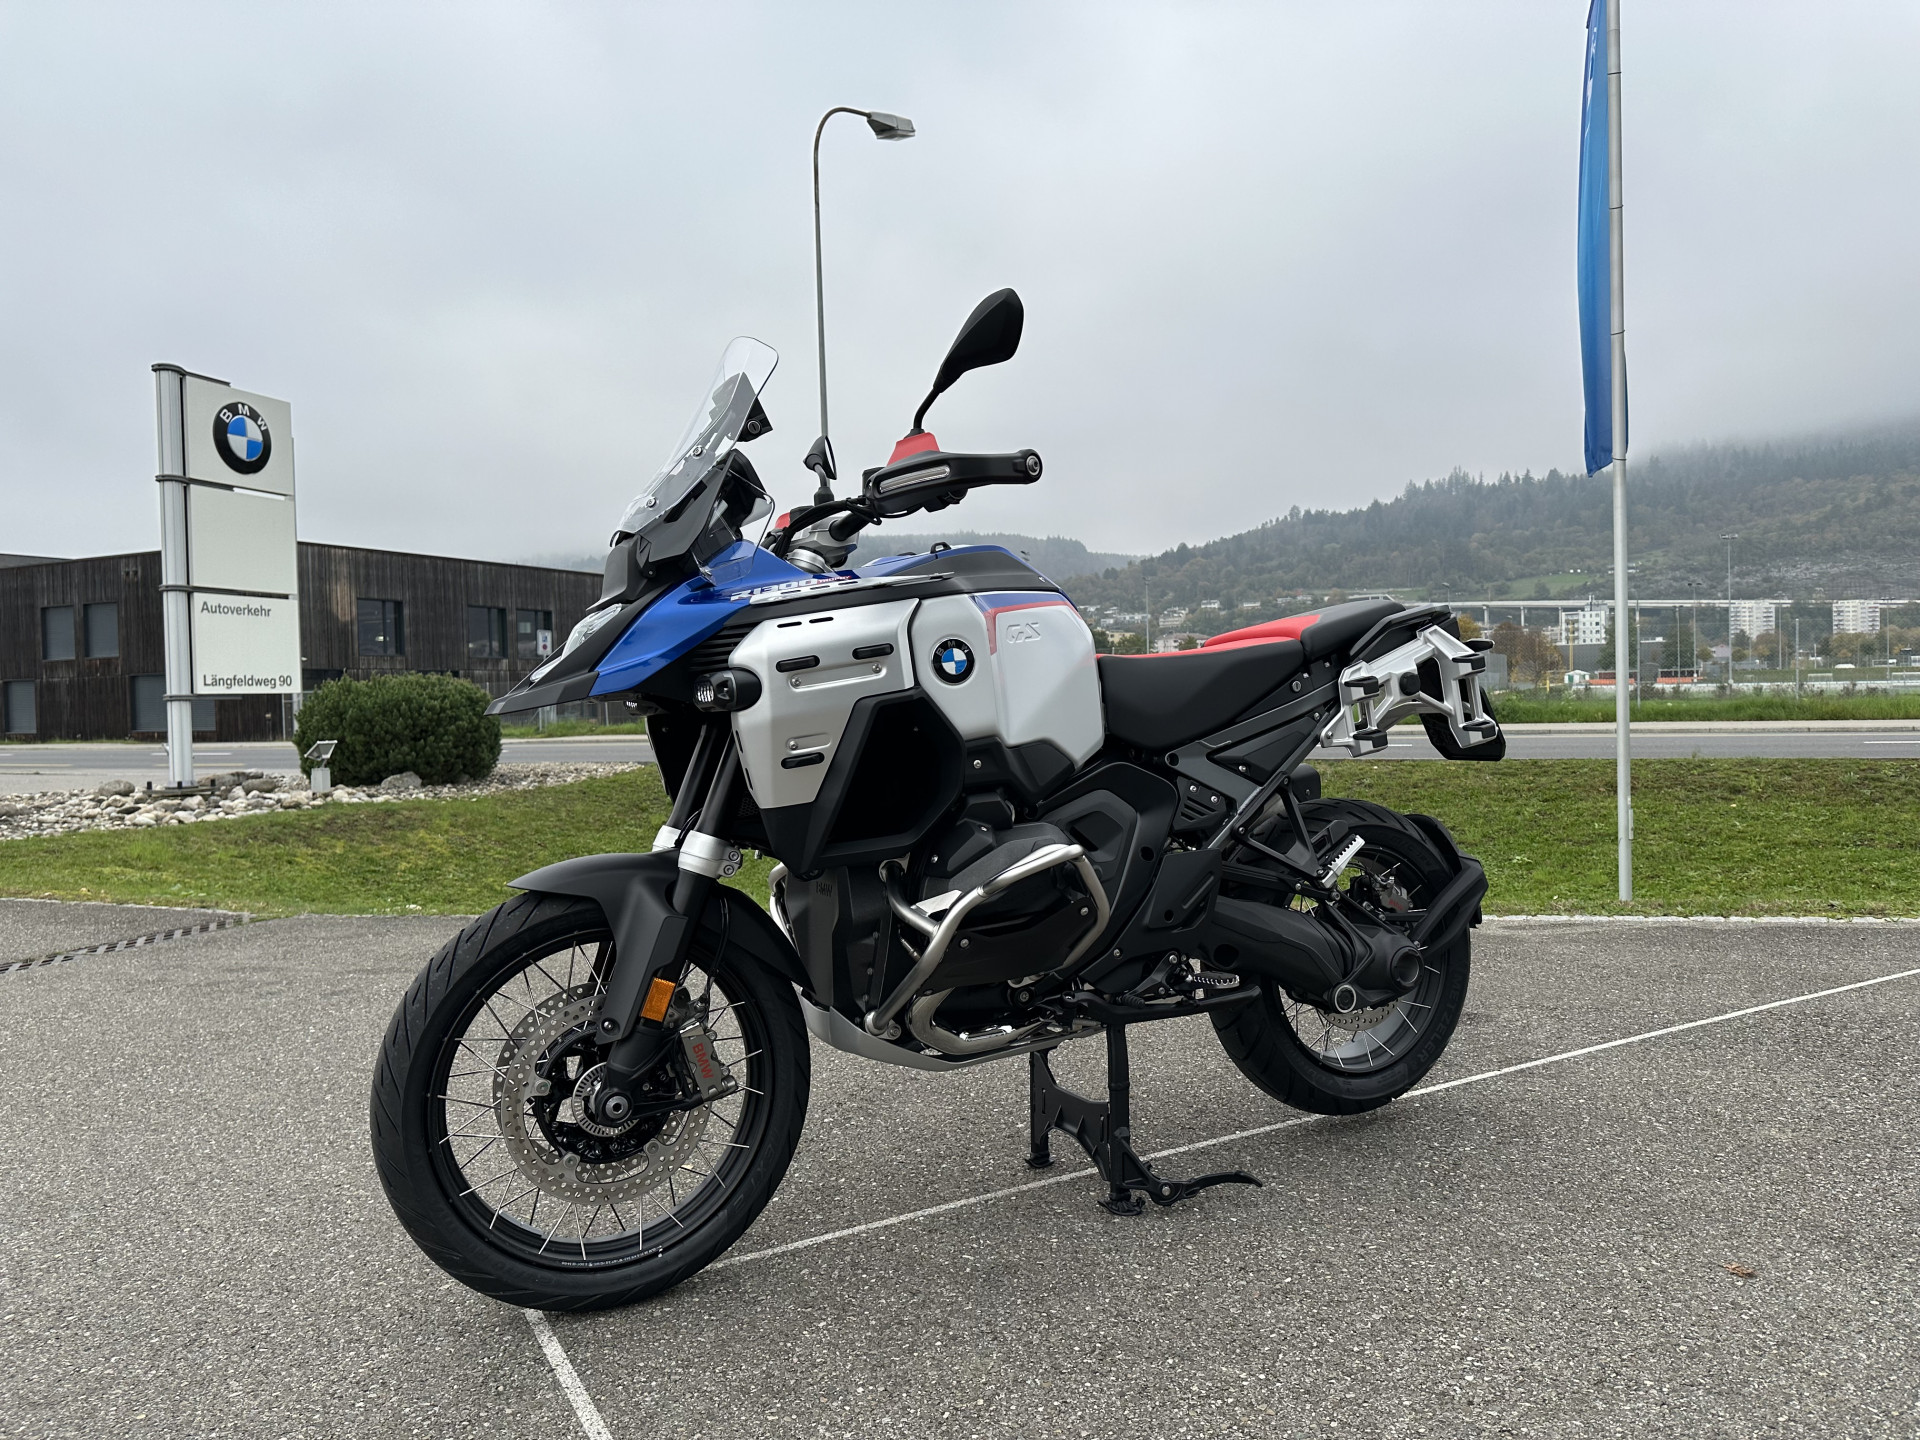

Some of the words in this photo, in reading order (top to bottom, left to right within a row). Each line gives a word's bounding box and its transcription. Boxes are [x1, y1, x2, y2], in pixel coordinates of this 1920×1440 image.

[219, 403, 267, 431] BMW
[201, 601, 271, 617] Autoverkehr
[1006, 622, 1041, 643] GS
[936, 640, 970, 656] BMW
[203, 674, 276, 689] Längfeldweg
[279, 675, 292, 687] 90
[1416, 975, 1463, 1063] METZELER
[692, 1042, 715, 1079] BMW
